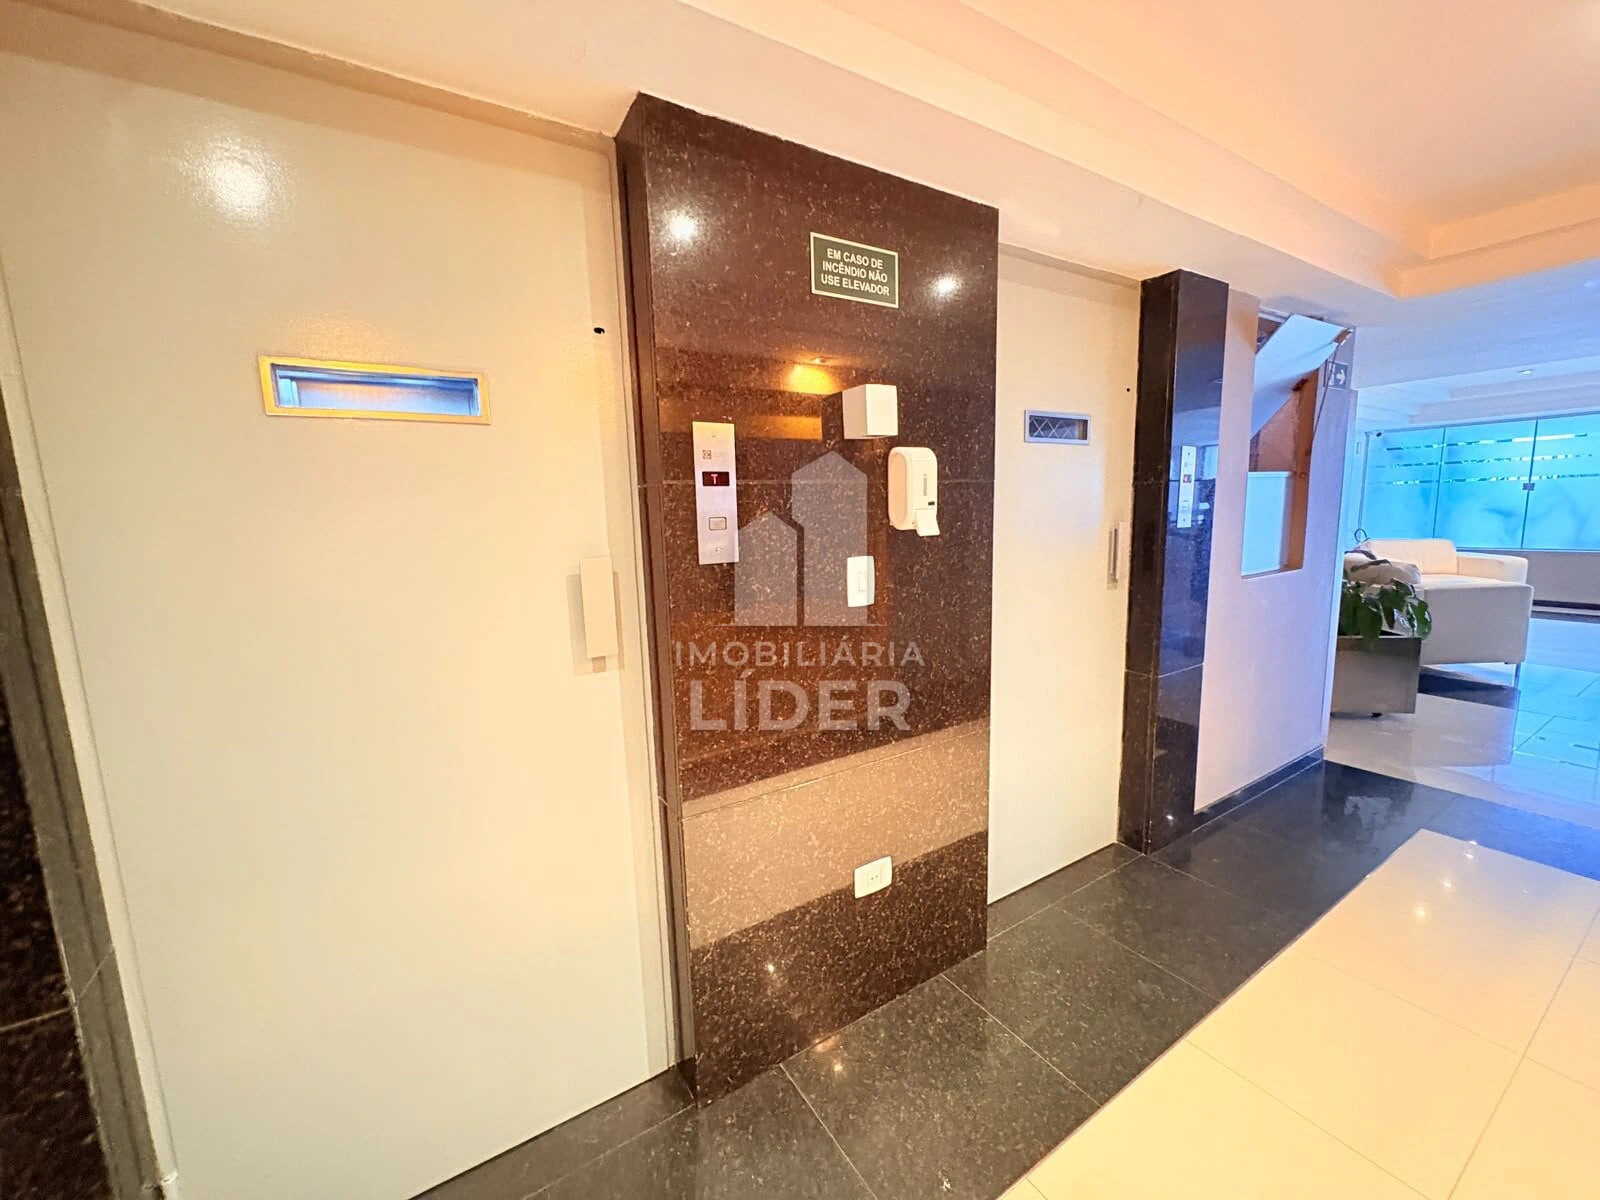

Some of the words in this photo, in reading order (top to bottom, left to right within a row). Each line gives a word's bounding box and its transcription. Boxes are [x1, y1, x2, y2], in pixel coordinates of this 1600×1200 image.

[827, 248, 841, 260] EM
[843, 252, 869, 266] CASO
[871, 259, 883, 269] DE
[822, 261, 867, 278] INCÊNDIO
[869, 269, 888, 283] NÃO
[821, 274, 841, 286] USE
[842, 278, 890, 296] ELEVADOR
